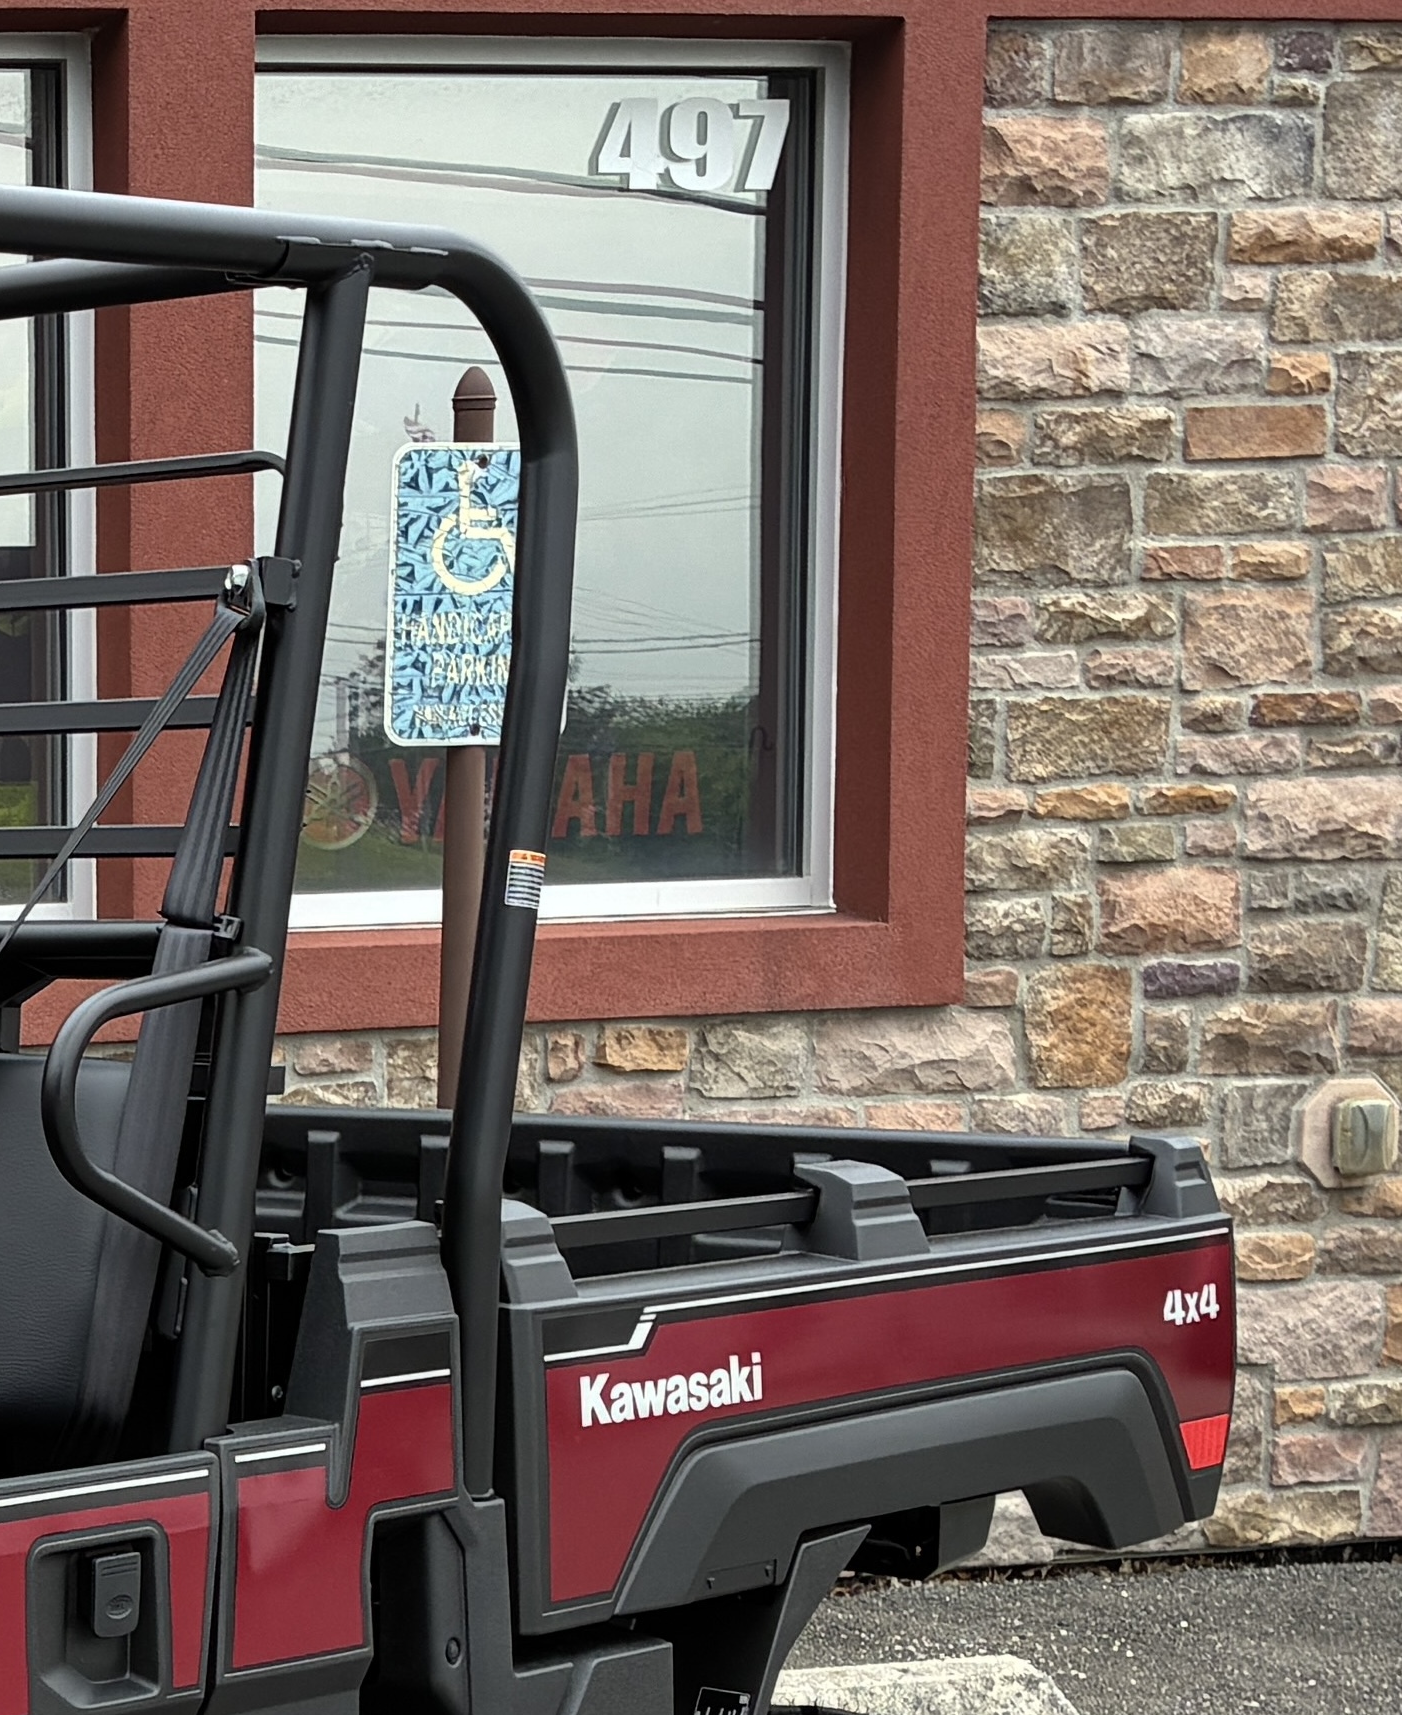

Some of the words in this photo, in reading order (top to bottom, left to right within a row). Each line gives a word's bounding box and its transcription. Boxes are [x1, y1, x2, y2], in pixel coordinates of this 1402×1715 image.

[591, 96, 791, 192] 497
[429, 650, 512, 688] PARKIN
[1163, 1282, 1220, 1326] 4x4
[579, 1351, 763, 1428] Kawasaki
